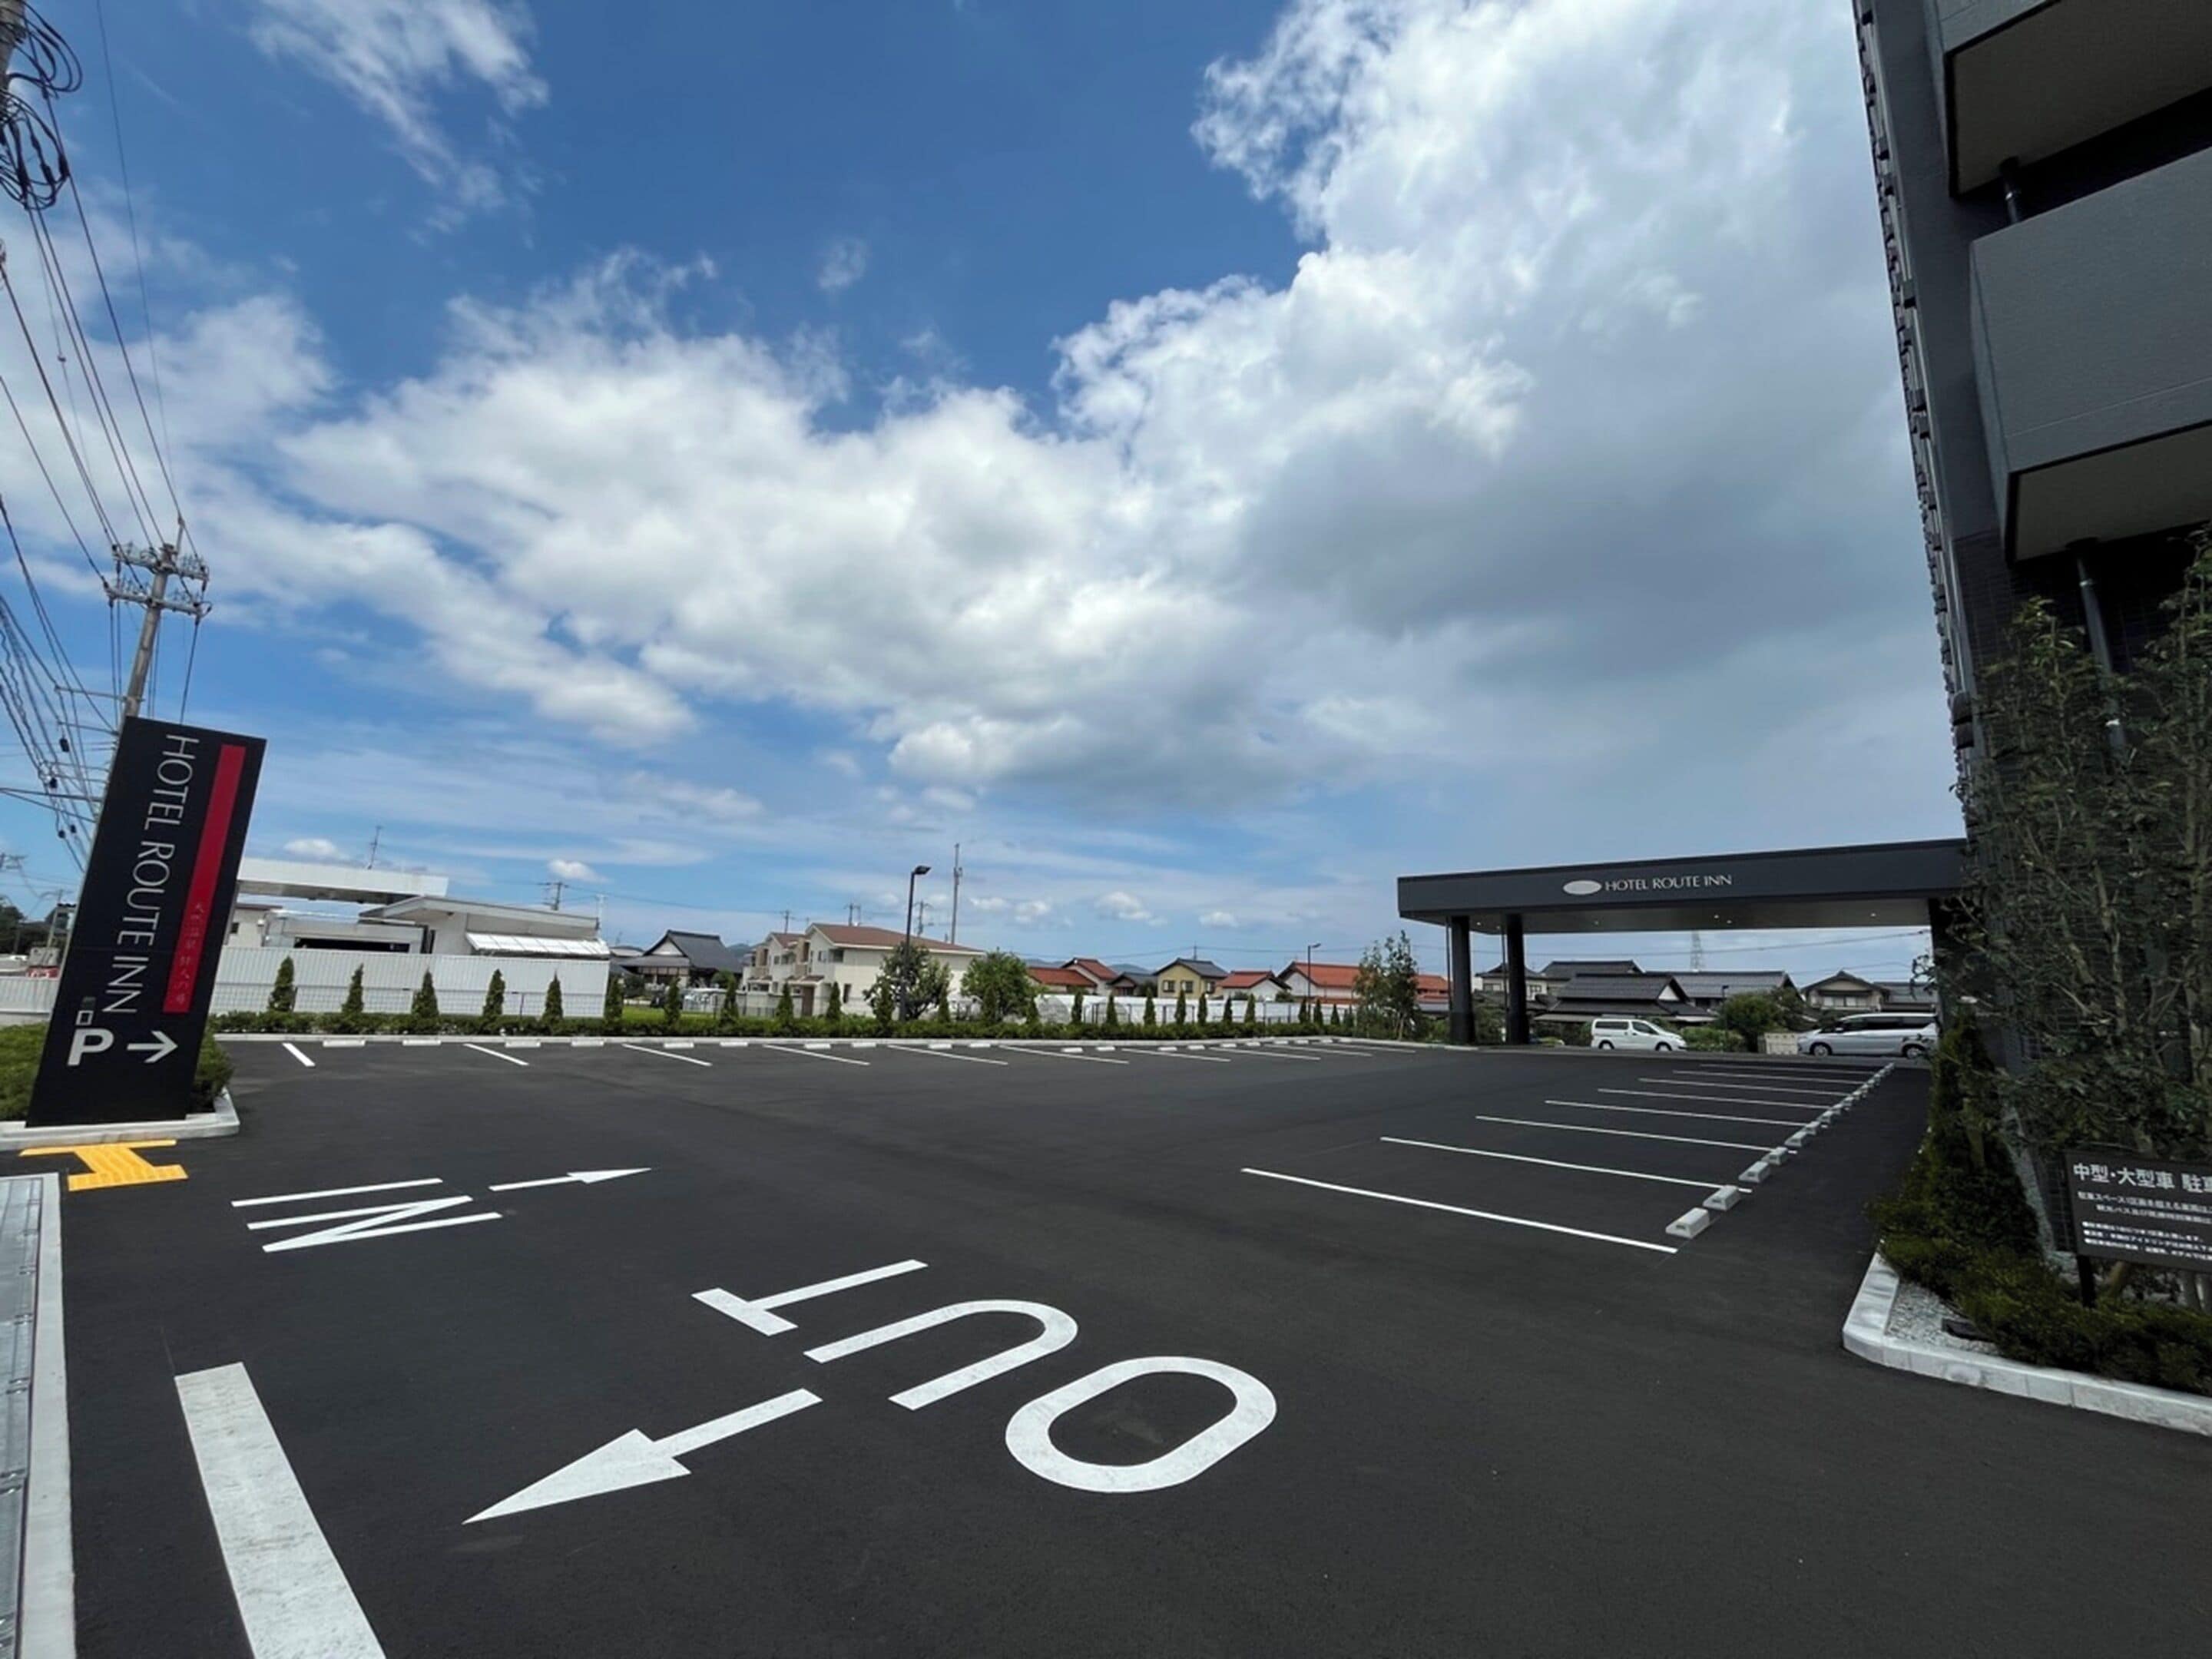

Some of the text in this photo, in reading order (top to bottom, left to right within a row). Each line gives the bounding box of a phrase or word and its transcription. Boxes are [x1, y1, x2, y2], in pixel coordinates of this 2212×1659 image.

[103, 734, 199, 1013] HOTEL ROUTE INN
[1605, 875, 1732, 891] HOTEL ROUTE INN
[68, 1028, 114, 1066] P
[2074, 1163, 2175, 1189] 中型・大型車
[231, 1177, 502, 1253] IN
[692, 1260, 1277, 1492] OUT
